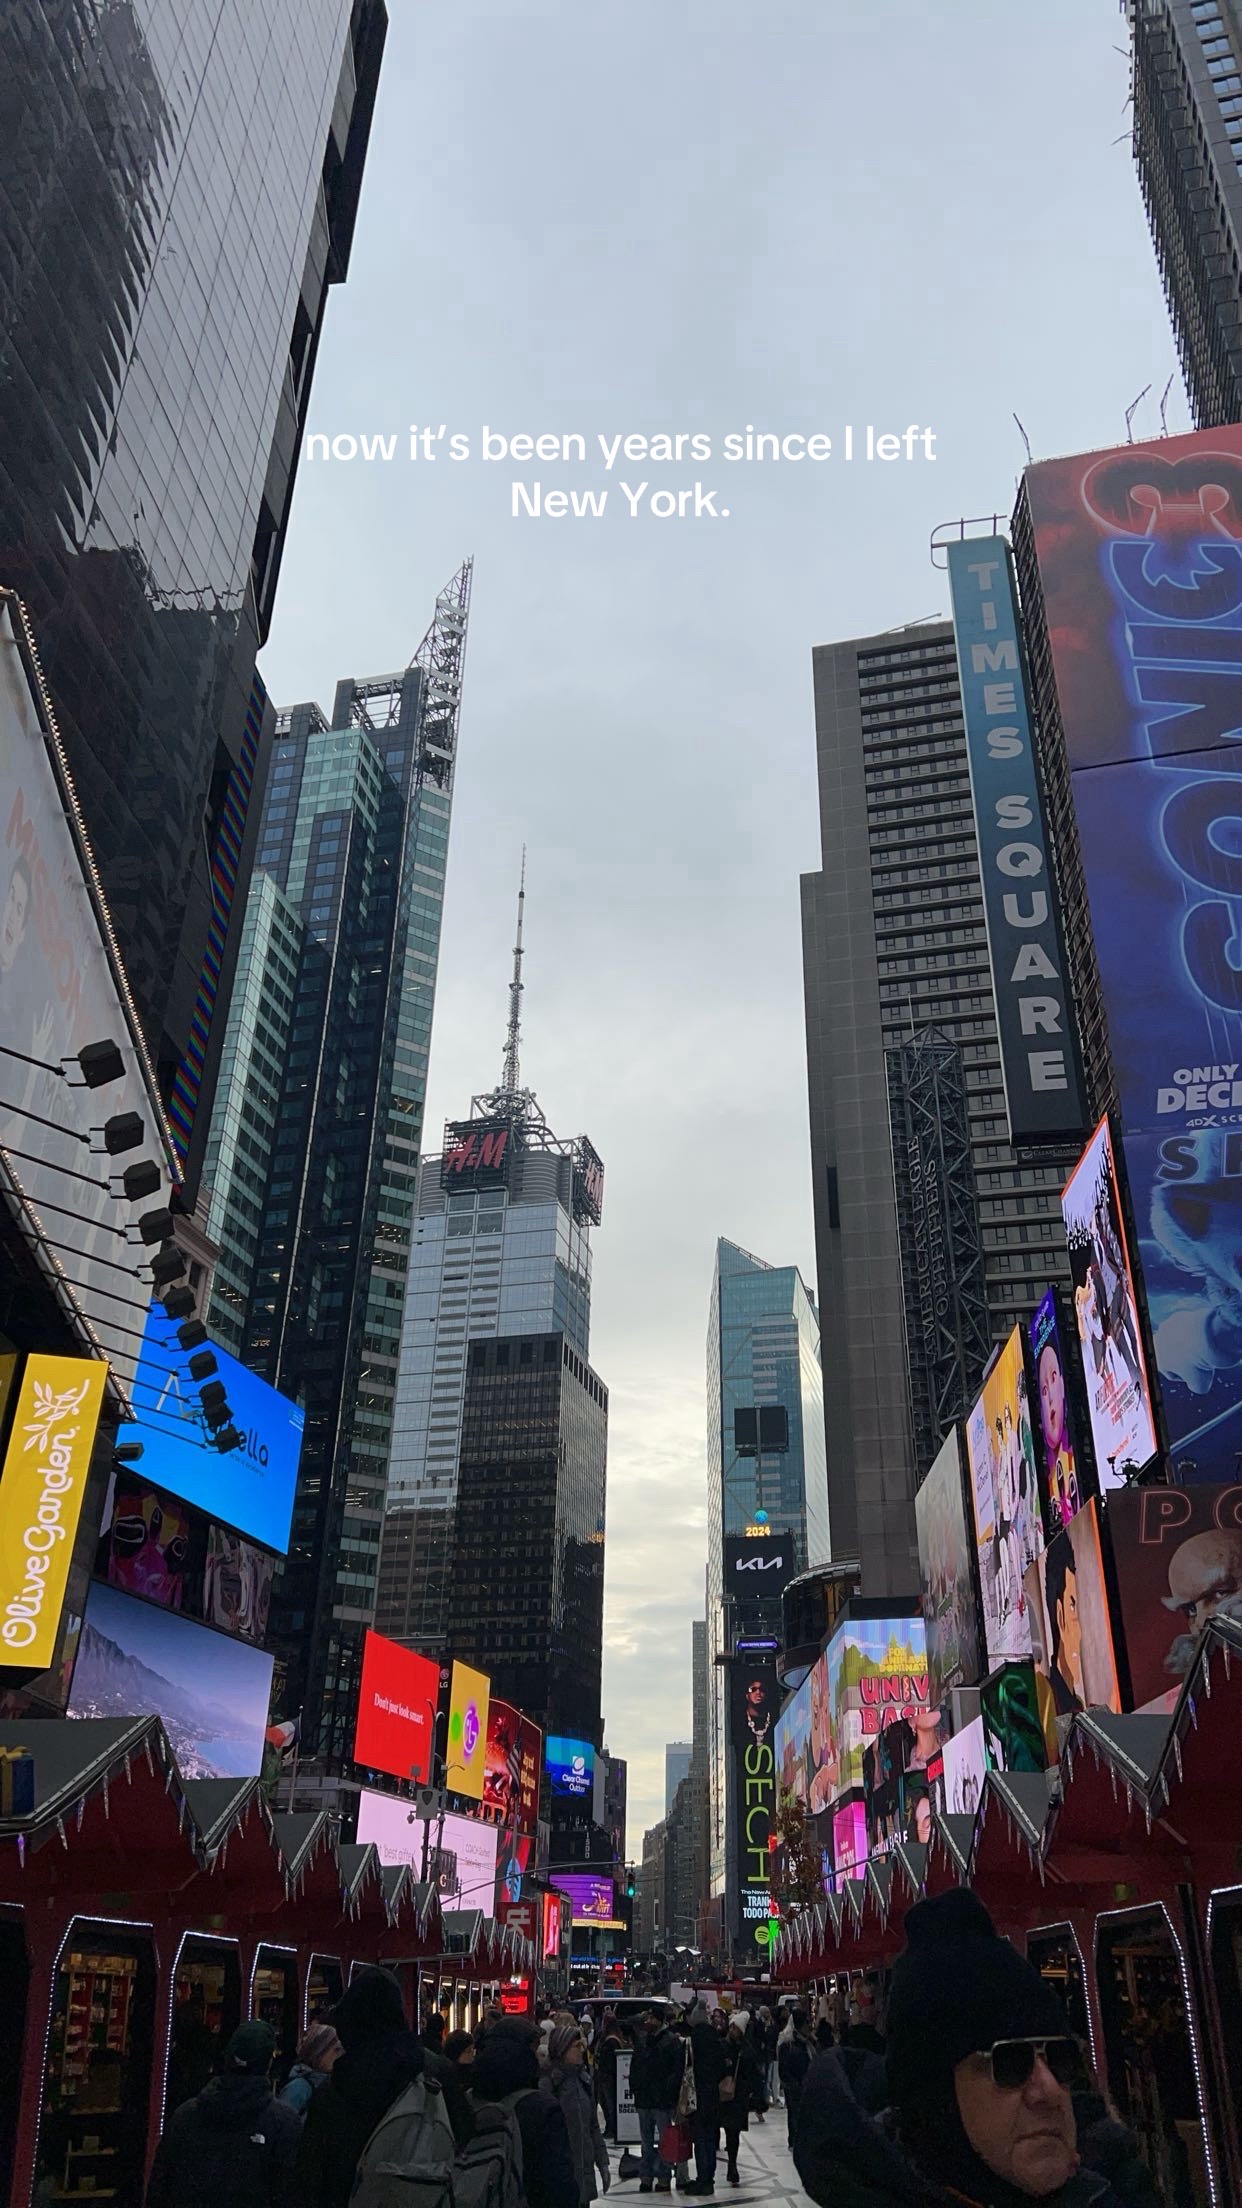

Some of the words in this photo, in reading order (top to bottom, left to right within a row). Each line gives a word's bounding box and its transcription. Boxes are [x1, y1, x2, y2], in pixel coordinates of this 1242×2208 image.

[967, 562, 1023, 761] TIMES
[995, 795, 1068, 1092] SQUARE
[1173, 1064, 1239, 1085] ONLY
[445, 1130, 508, 1173] H&M
[906, 1135, 925, 1212] EAGLE
[923, 1159, 949, 1317] OUTFITTERS
[914, 1214, 938, 1357] AMERICAN
[23, 1428, 73, 1552] Garden
[745, 1526, 771, 1537] 2024
[2, 1555, 49, 1648] Olive
[744, 1744, 772, 1882] SECH
[742, 1907, 763, 1919] TODO
